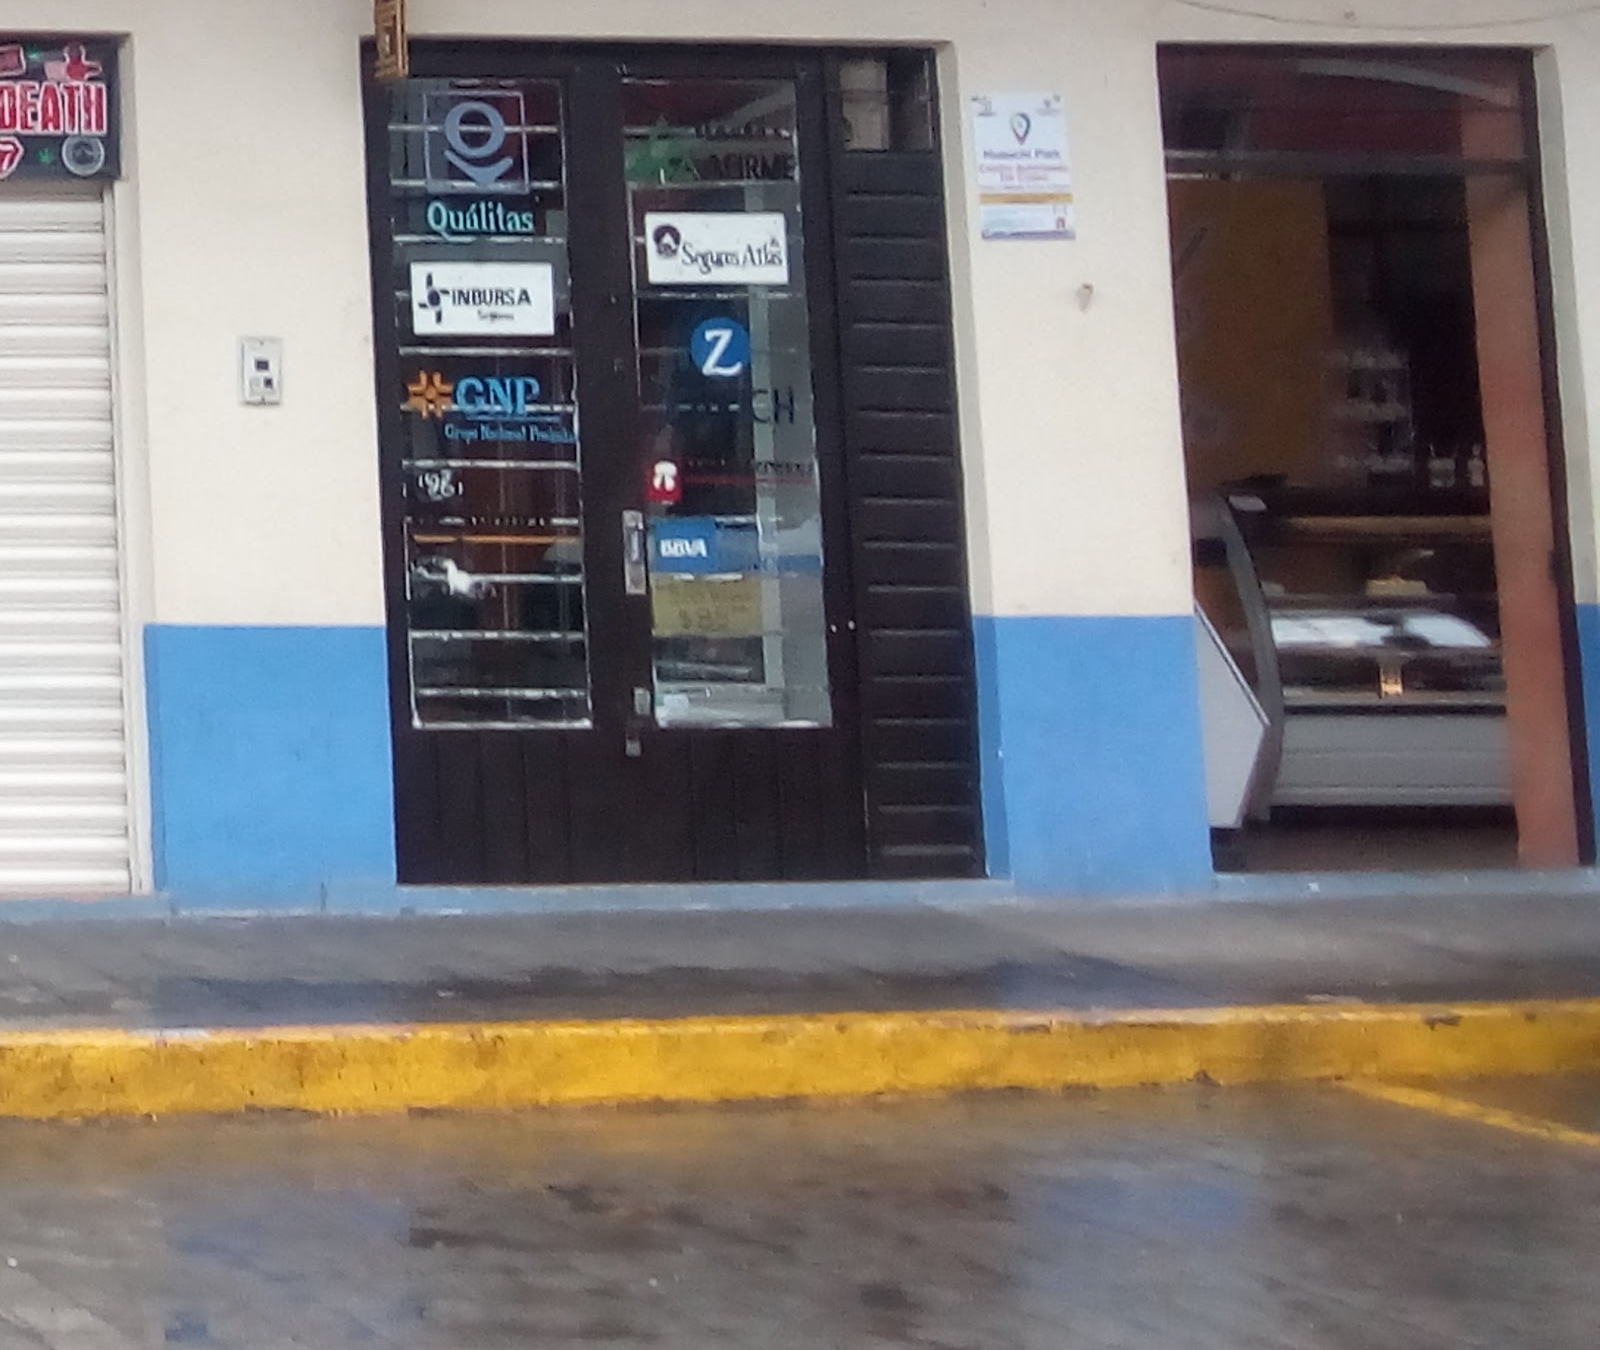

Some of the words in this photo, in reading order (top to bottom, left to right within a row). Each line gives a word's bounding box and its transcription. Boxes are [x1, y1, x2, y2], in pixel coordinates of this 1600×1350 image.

[427, 201, 535, 242] Quálitas
[681, 241, 740, 275] Seguros
[742, 243, 783, 266] Atlas
[452, 288, 533, 307] INBURSA
[456, 376, 541, 416] GNP
[660, 537, 708, 559] BBVA
